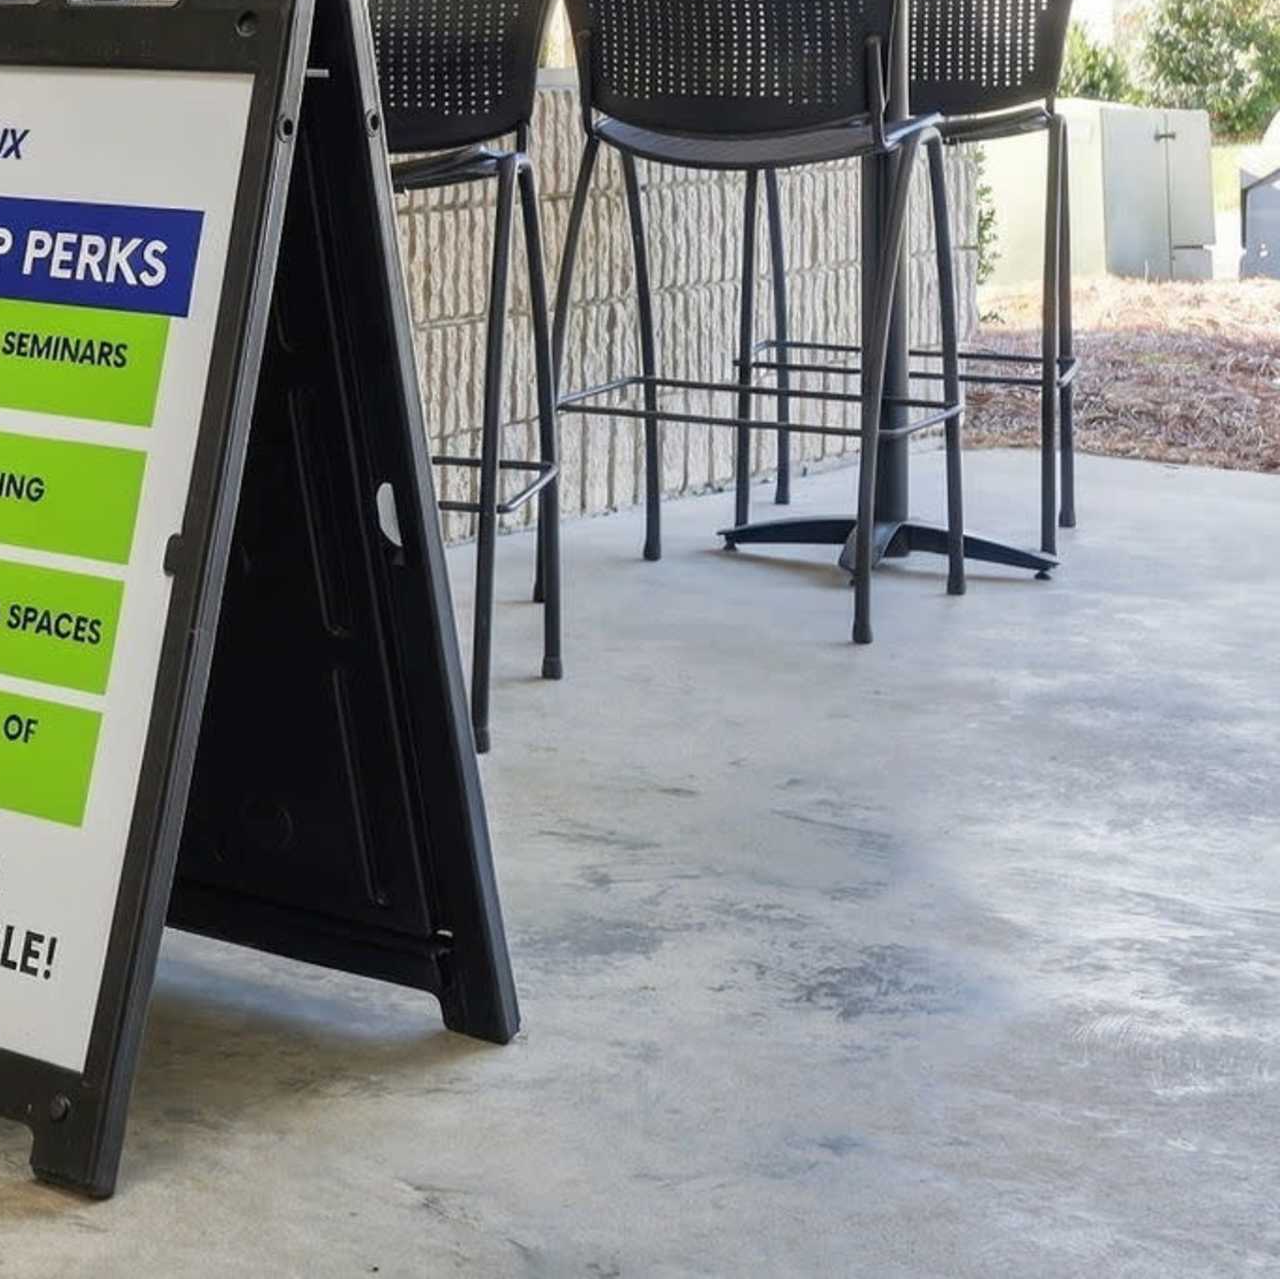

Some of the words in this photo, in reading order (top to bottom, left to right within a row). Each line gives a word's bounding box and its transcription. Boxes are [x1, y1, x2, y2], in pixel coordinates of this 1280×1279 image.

[22, 231, 168, 287] PERKS
[2, 332, 128, 369] SEMINARS
[7, 603, 102, 646] SPACES
[4, 714, 39, 744] OF
